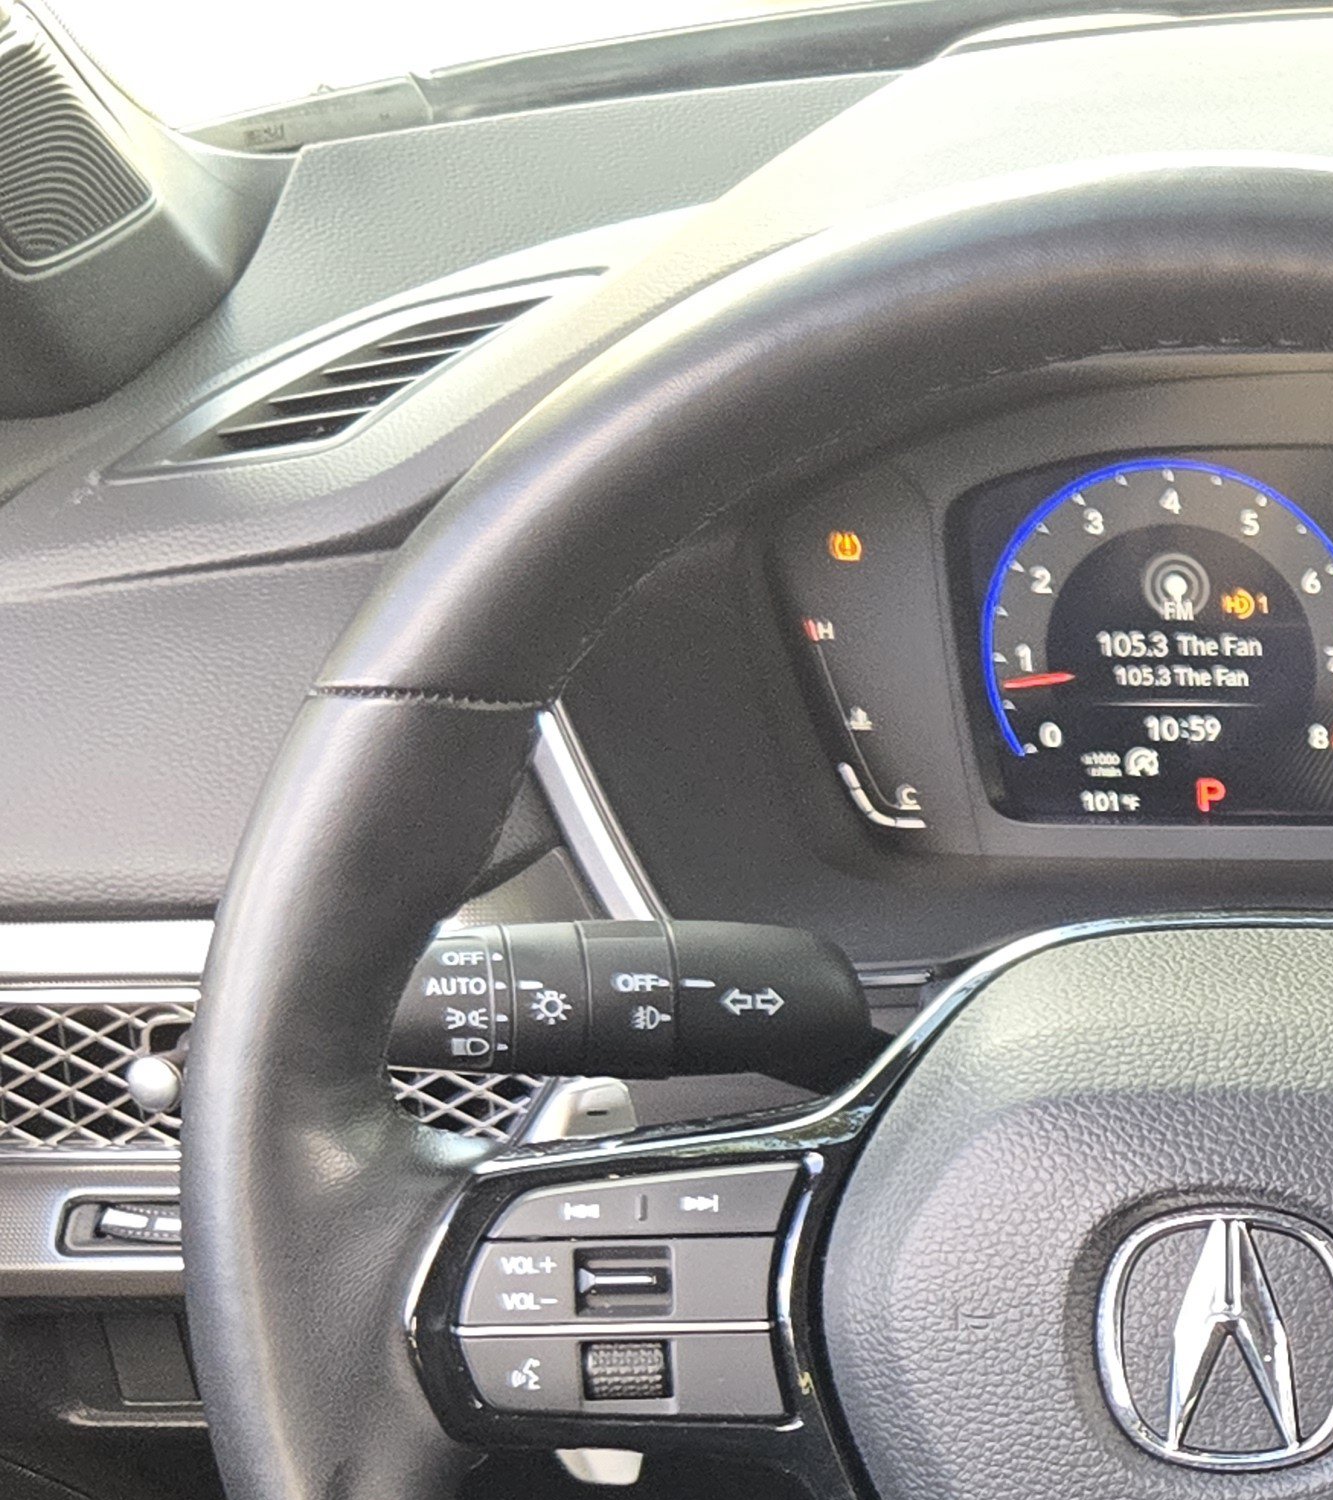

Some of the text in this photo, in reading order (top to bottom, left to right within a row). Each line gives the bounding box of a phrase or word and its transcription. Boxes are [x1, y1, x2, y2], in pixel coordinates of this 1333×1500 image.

[1160, 489, 1182, 514] 4
[1085, 509, 1104, 534] 3
[1240, 510, 1260, 535] 5
[1031, 567, 1053, 594] 2
[1302, 569, 1321, 593] 6
[1163, 600, 1194, 620] FM
[817, 620, 835, 641] H
[1097, 631, 1263, 658] 105.3 The Fan
[1016, 645, 1032, 671] 1
[1115, 664, 1249, 686] 105.3 The Fan
[1039, 722, 1062, 748] 0
[1145, 715, 1221, 742] 10:59
[1308, 724, 1330, 748] 8
[1195, 777, 1227, 812] P
[442, 952, 485, 965] OFF
[426, 978, 486, 994] AUTO
[613, 975, 658, 991] OFF
